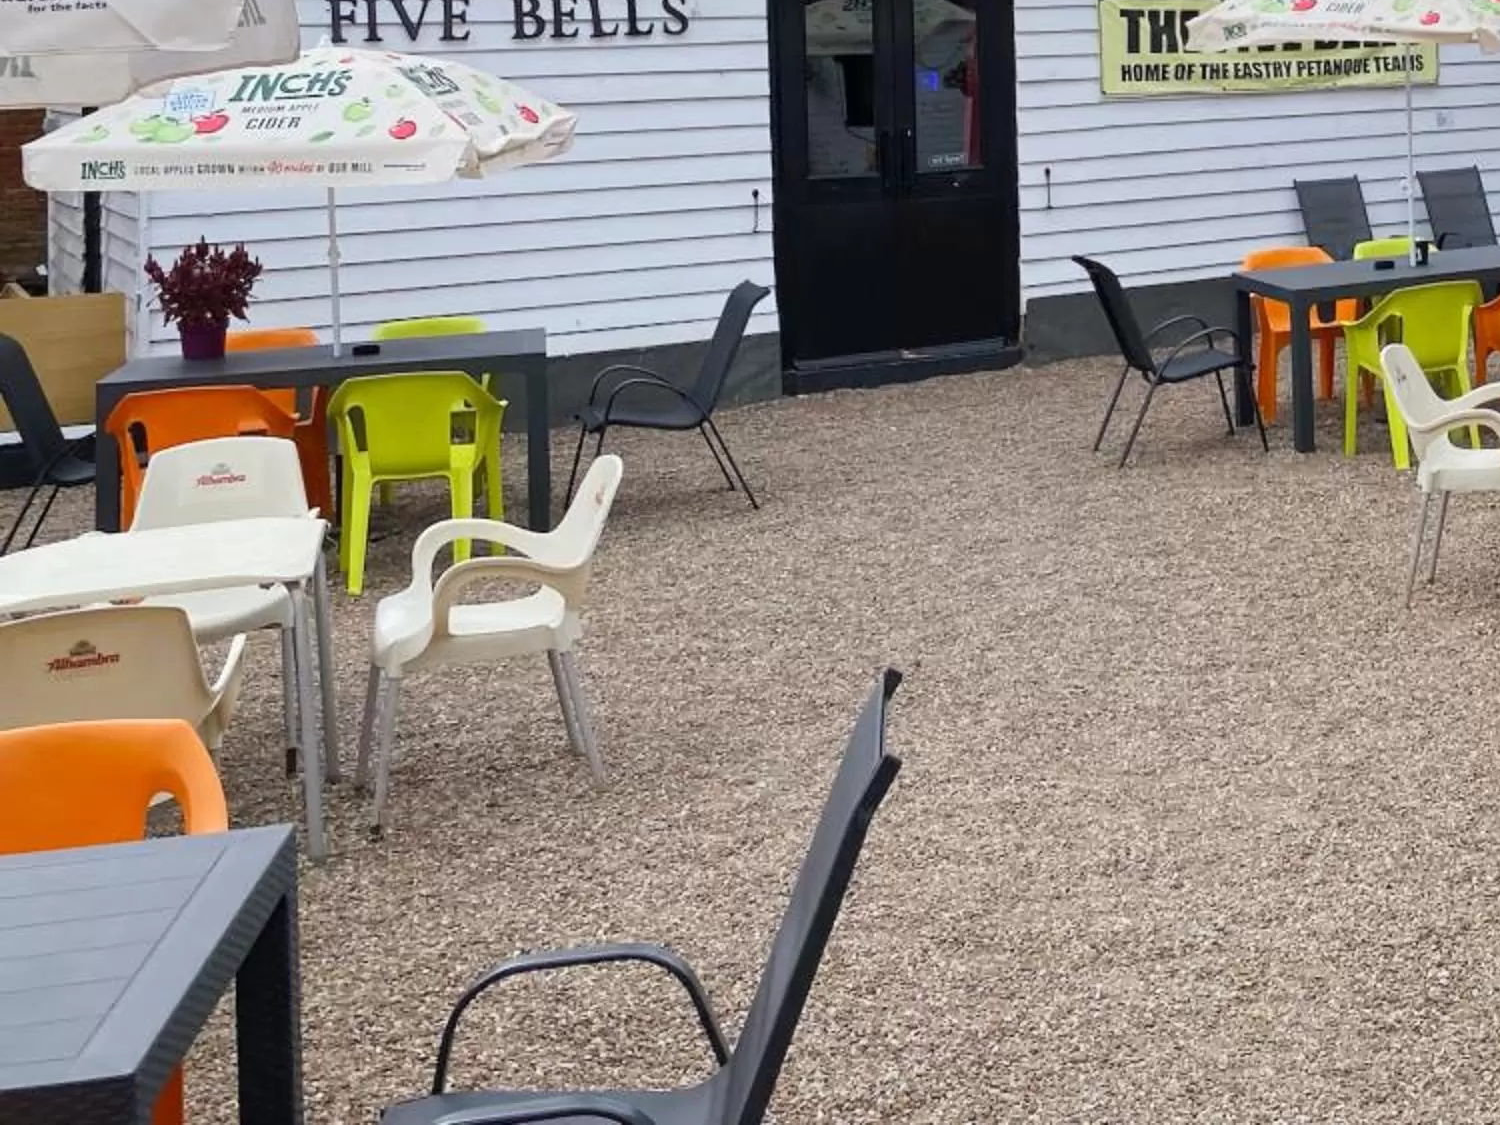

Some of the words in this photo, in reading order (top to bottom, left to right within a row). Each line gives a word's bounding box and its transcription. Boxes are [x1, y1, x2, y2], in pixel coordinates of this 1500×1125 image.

[28, 4, 46, 14] for
[50, 2, 72, 12] the
[75, 0, 108, 11] facts
[1120, 63, 1171, 83] HOME
[1174, 62, 1197, 81] OF
[1200, 61, 1229, 80] THE
[1233, 59, 1293, 80] EASTRY
[1296, 57, 1370, 77] PETANQUE
[228, 68, 353, 102] INCH'S
[245, 116, 301, 130] CIDER
[47, 652, 121, 672] Alhambra
